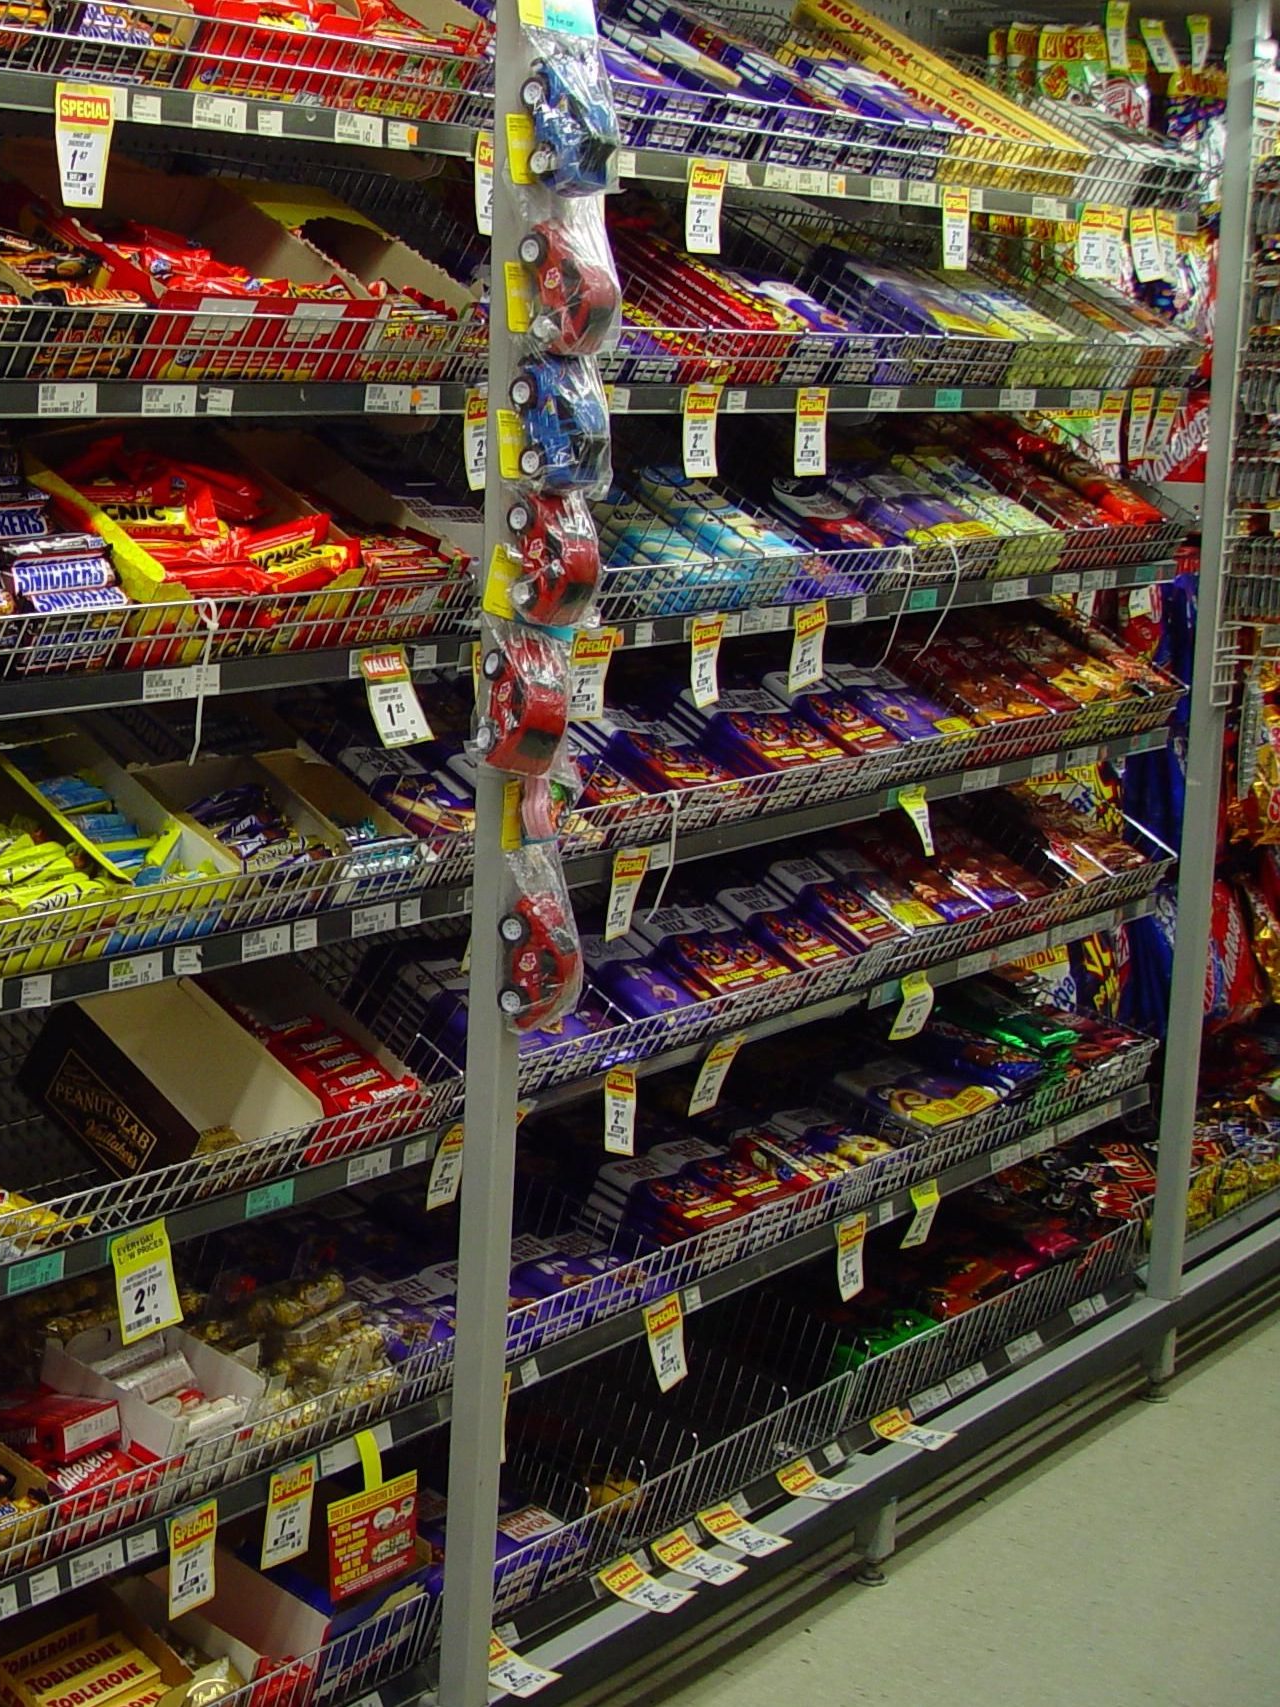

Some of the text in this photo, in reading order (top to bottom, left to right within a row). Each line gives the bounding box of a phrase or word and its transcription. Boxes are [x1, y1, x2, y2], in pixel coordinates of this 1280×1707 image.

[61, 99, 110, 120] SPECIAL
[70, 150, 88, 170] 1 47
[693, 169, 723, 185] SPECIAL
[687, 395, 716, 409] SPECIAL
[798, 398, 825, 411] SPECIAL
[16, 558, 106, 594] SNICKERS
[37, 588, 126, 613] SNICKERS
[576, 639, 610, 654] SPECIAL
[363, 657, 404, 673] VALUE
[386, 703, 406, 726] 1 25
[55, 1083, 149, 1151] PEANUT SLAB
[116, 1232, 155, 1257] EVERYDAY
[118, 1239, 164, 1265] LW PRICES
[134, 1283, 157, 1315] 2 19
[273, 1468, 313, 1499] SPECIAL
[174, 1515, 215, 1541] SPECIAL
[28, 1642, 122, 1696] TOBLERONE
[46, 1664, 143, 1707] TOBLERONE
